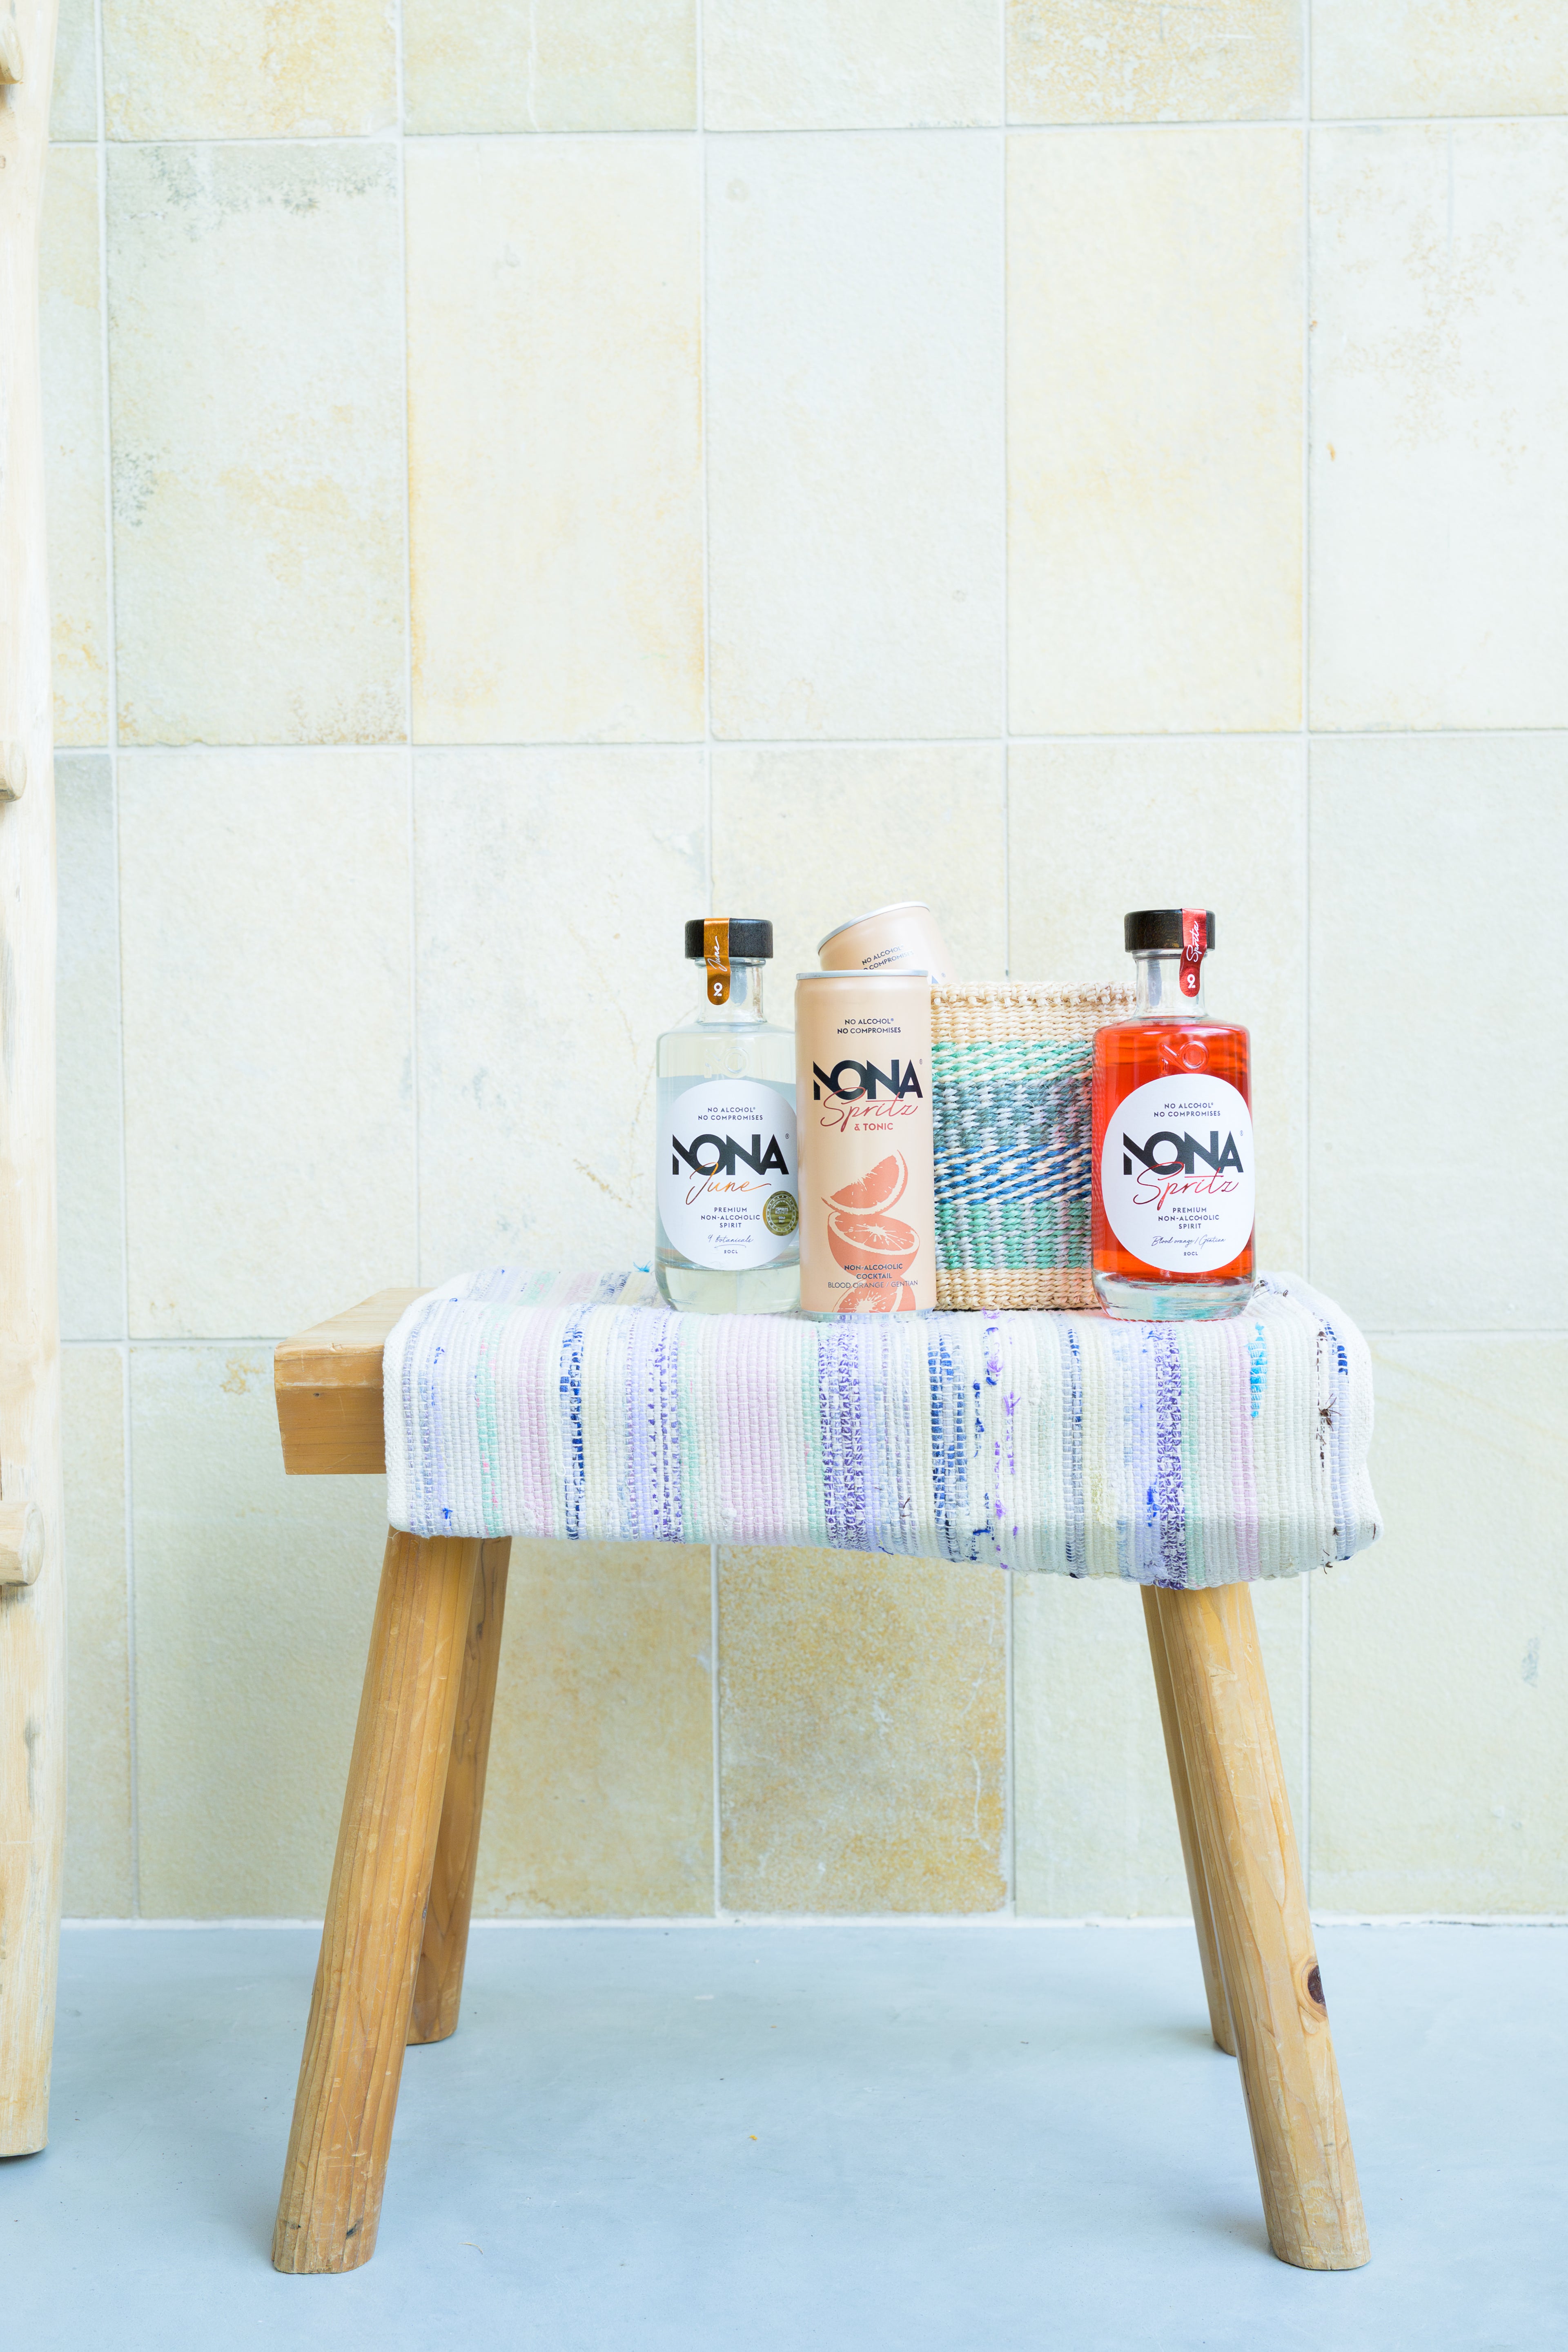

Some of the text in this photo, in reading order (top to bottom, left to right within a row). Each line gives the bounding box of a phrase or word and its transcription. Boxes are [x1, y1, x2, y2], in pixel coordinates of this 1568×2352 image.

[708, 936, 728, 972] June
[862, 957, 872, 965] NO
[869, 951, 914, 970] COMPROMISES
[813, 1059, 923, 1100] NONA
[820, 1087, 918, 1132] Spritz
[673, 1134, 789, 1176] NONA
[1123, 1131, 1244, 1175] NONA
[686, 1162, 772, 1205] June
[1133, 1161, 1239, 1211] Spritz
[1152, 1236, 1173, 1246] Blood
[1174, 1240, 1194, 1248] orange
[1199, 1234, 1225, 1250] Gentian
